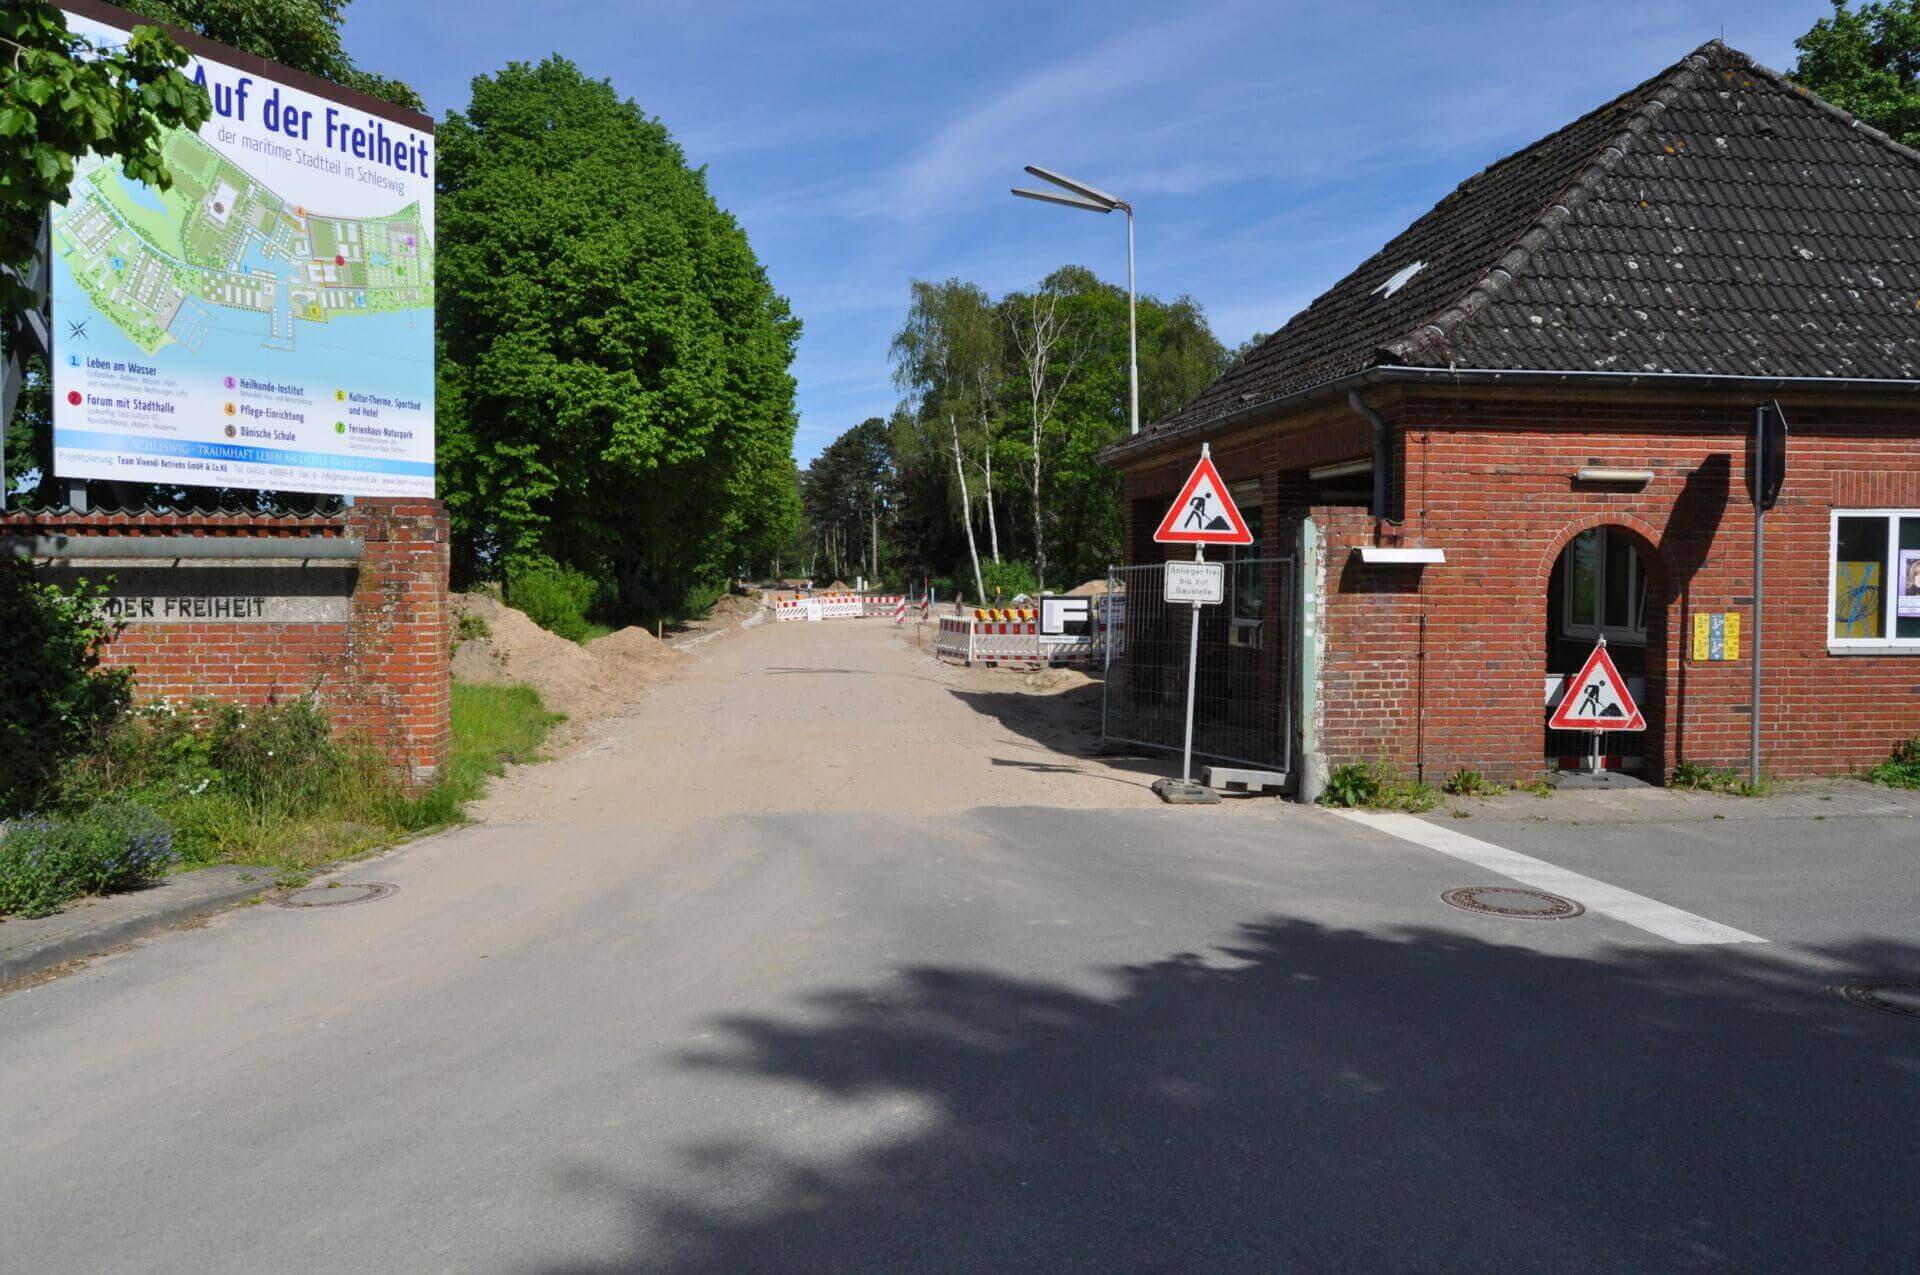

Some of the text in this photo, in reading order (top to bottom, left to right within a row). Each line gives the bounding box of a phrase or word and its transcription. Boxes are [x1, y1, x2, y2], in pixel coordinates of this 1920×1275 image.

[263, 88, 313, 141] der
[326, 107, 429, 179] Freiheit
[217, 126, 406, 197] der maritime Stadtteil in Schleswig
[71, 355, 157, 376] 1. Leben am Wasser
[240, 377, 304, 396] Heilkunde-Institut
[87, 393, 175, 414] Forum mit Stadthalle
[349, 406, 379, 418] und Hotel
[395, 398, 421, 410] Sportbad
[240, 404, 304, 424] Pflege-Einrichtung
[240, 426, 272, 439] Dänische
[273, 429, 296, 441] Schule
[348, 423, 413, 439] Ferienhaus-Naturpark
[58, 451, 114, 466] Projektplanung:
[117, 455, 135, 465] Team
[136, 457, 160, 468] Vivendi
[161, 459, 186, 470] Betriebs
[187, 461, 204, 471] GmbH
[198, 444, 254, 460] TRAUMHAFT
[256, 449, 281, 463] LEBEN
[1170, 566, 1220, 577] Anlieger frei
[1175, 586, 1212, 595] Baustelle
[1195, 578, 1208, 586] zur
[109, 597, 265, 618] DER FREIHEIT
